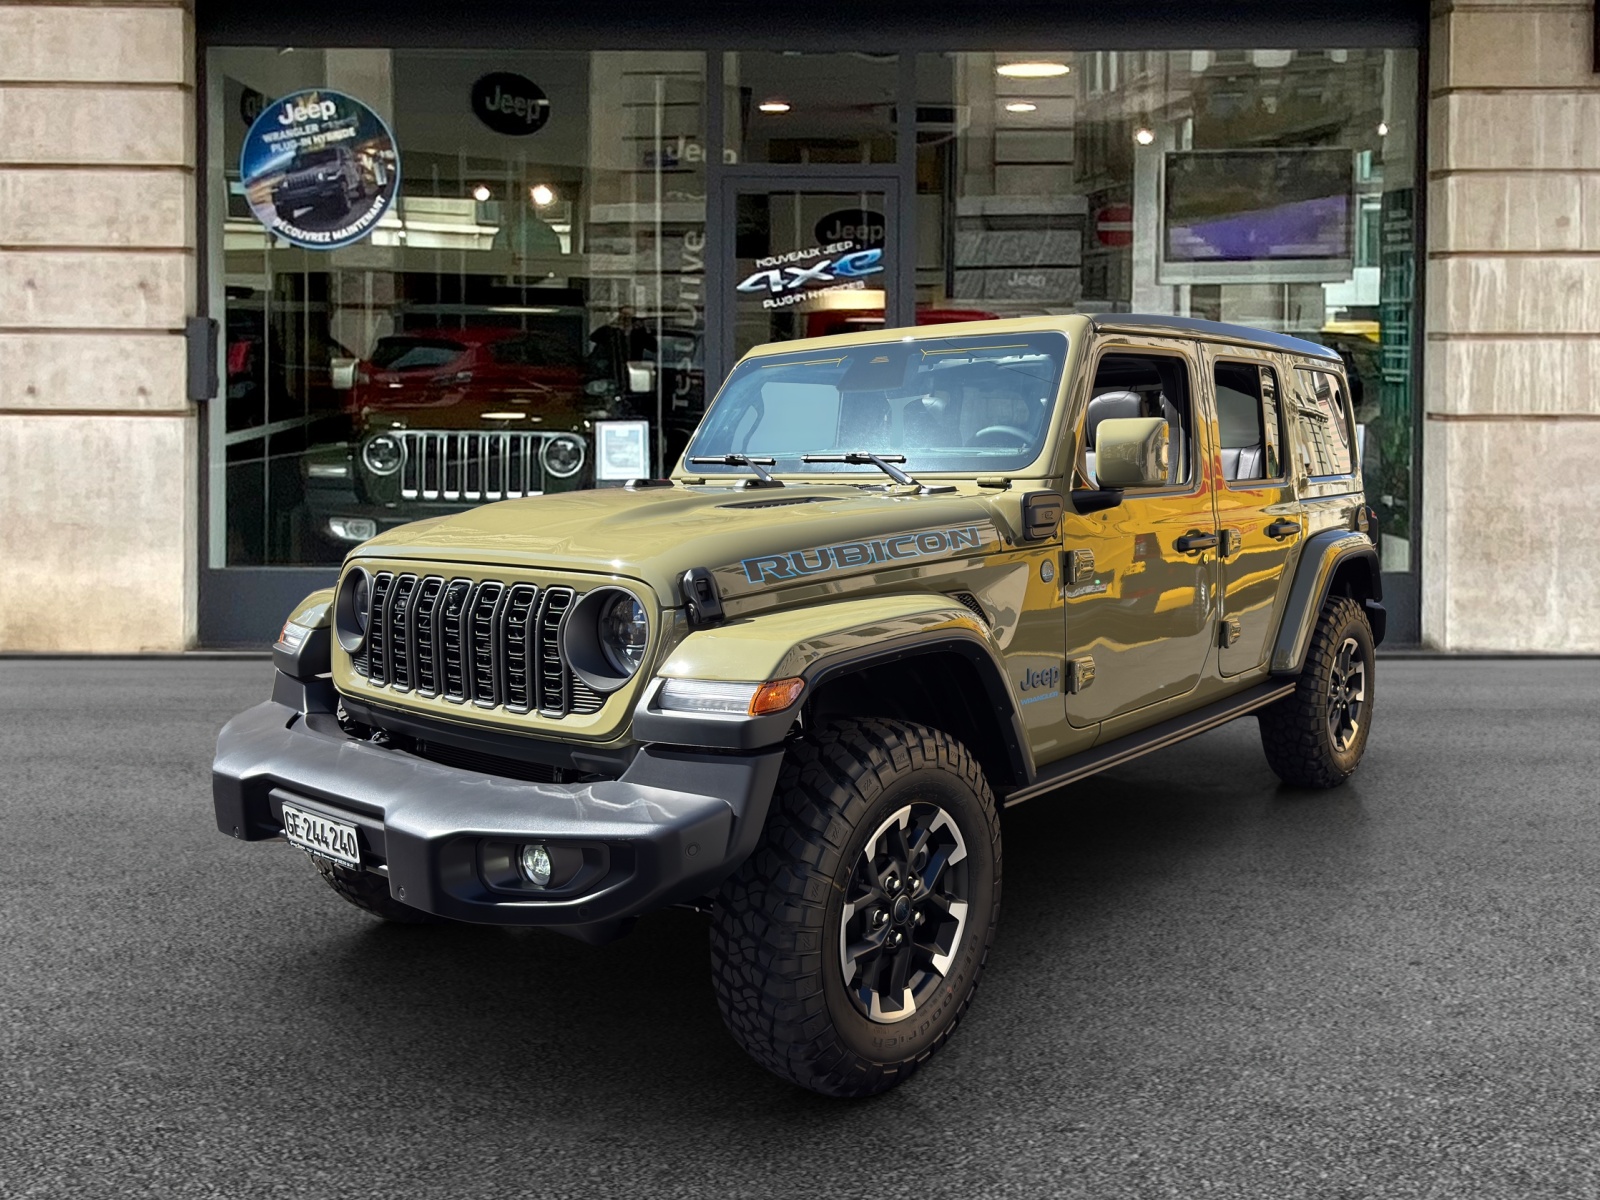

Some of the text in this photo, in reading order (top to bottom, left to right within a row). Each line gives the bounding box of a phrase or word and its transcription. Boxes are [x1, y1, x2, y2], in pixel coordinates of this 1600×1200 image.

[278, 99, 336, 125] Jeep
[485, 85, 541, 124] Jeep
[262, 123, 320, 143] WRANGLER
[270, 136, 312, 153] PLUG-IN
[272, 195, 386, 242] DÉCOUVREZ MAINTENANT
[826, 220, 884, 243] Jeep
[756, 240, 853, 268] NOUVEAUX JEEP
[674, 231, 706, 327] Drive
[741, 526, 981, 584] RUBICON
[1020, 667, 1060, 691] Jeep
